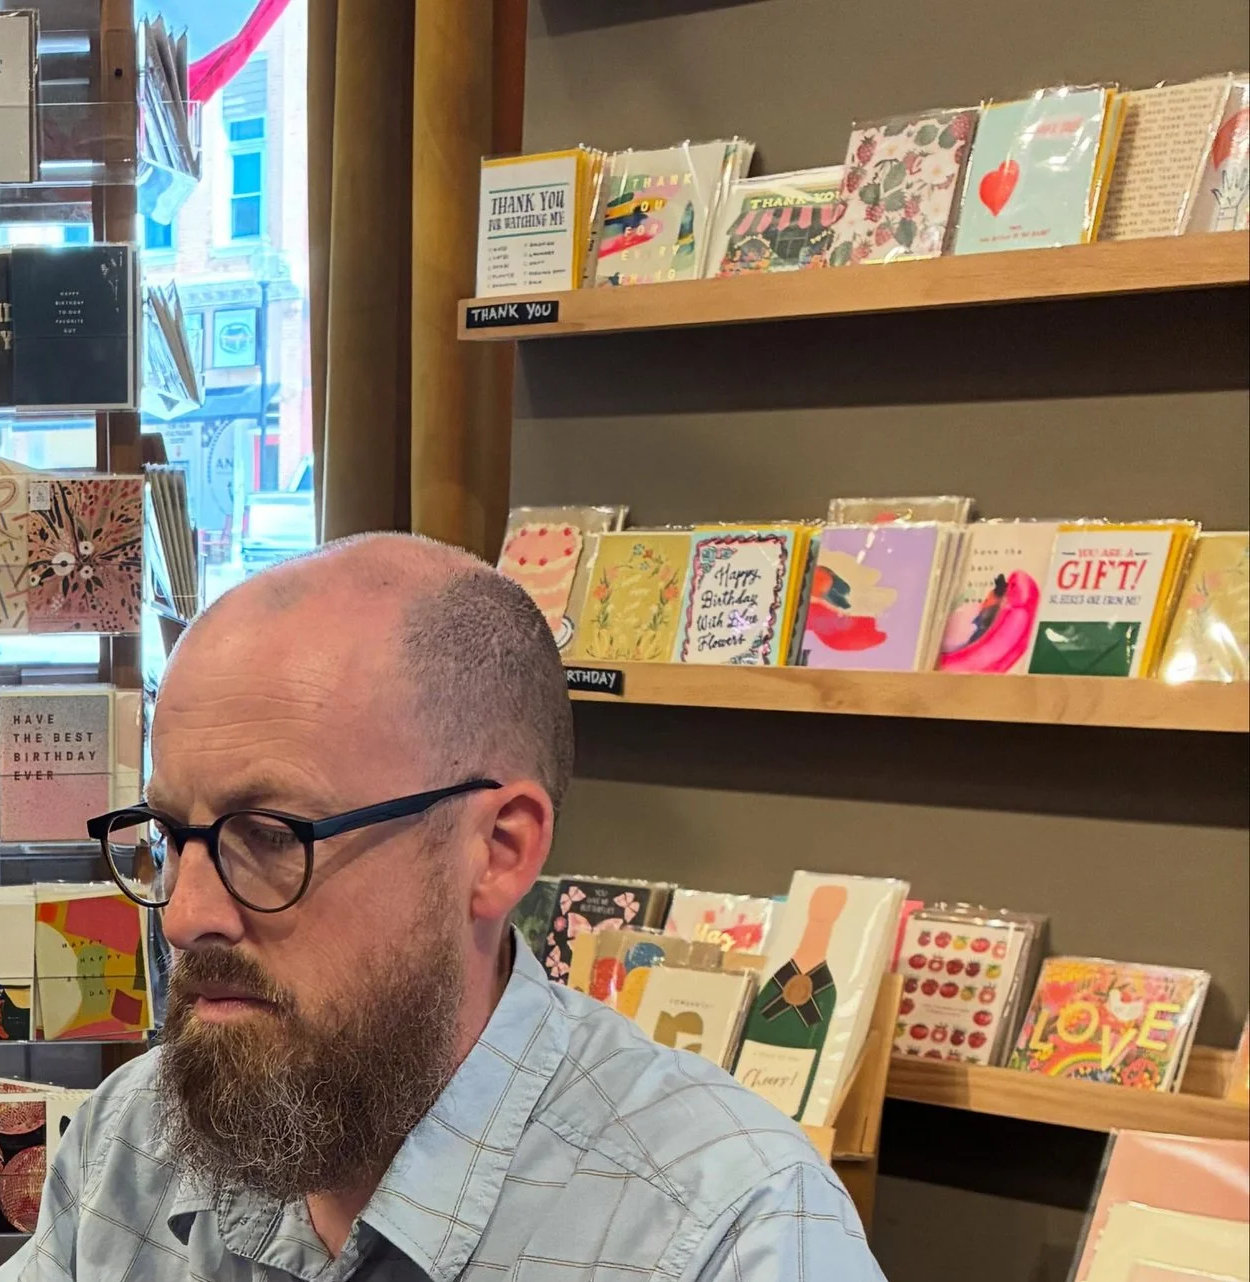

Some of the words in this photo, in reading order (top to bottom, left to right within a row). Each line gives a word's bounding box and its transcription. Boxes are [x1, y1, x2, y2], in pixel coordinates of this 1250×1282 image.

[631, 173, 692, 189] THANK
[491, 193, 535, 215] THANK
[540, 190, 565, 211] YOU
[750, 195, 808, 210] THANK
[504, 213, 547, 229] WATCHING
[471, 303, 519, 321] THANK
[526, 303, 551, 319] YOU
[715, 563, 761, 588] Happy
[1057, 560, 1147, 590] GIFT!
[701, 590, 758, 609] Birthday
[697, 611, 723, 631] With
[698, 632, 746, 652] Flowers
[566, 670, 616, 688] RTHDAY
[13, 714, 55, 725] HAVE
[13, 733, 43, 743] THE
[53, 732, 94, 743] BEST
[13, 751, 97, 762] BIRTHDAY
[13, 770, 54, 781] EVER
[80, 954, 121, 963] HAPPY
[1029, 1002, 1181, 1071] LOVE
